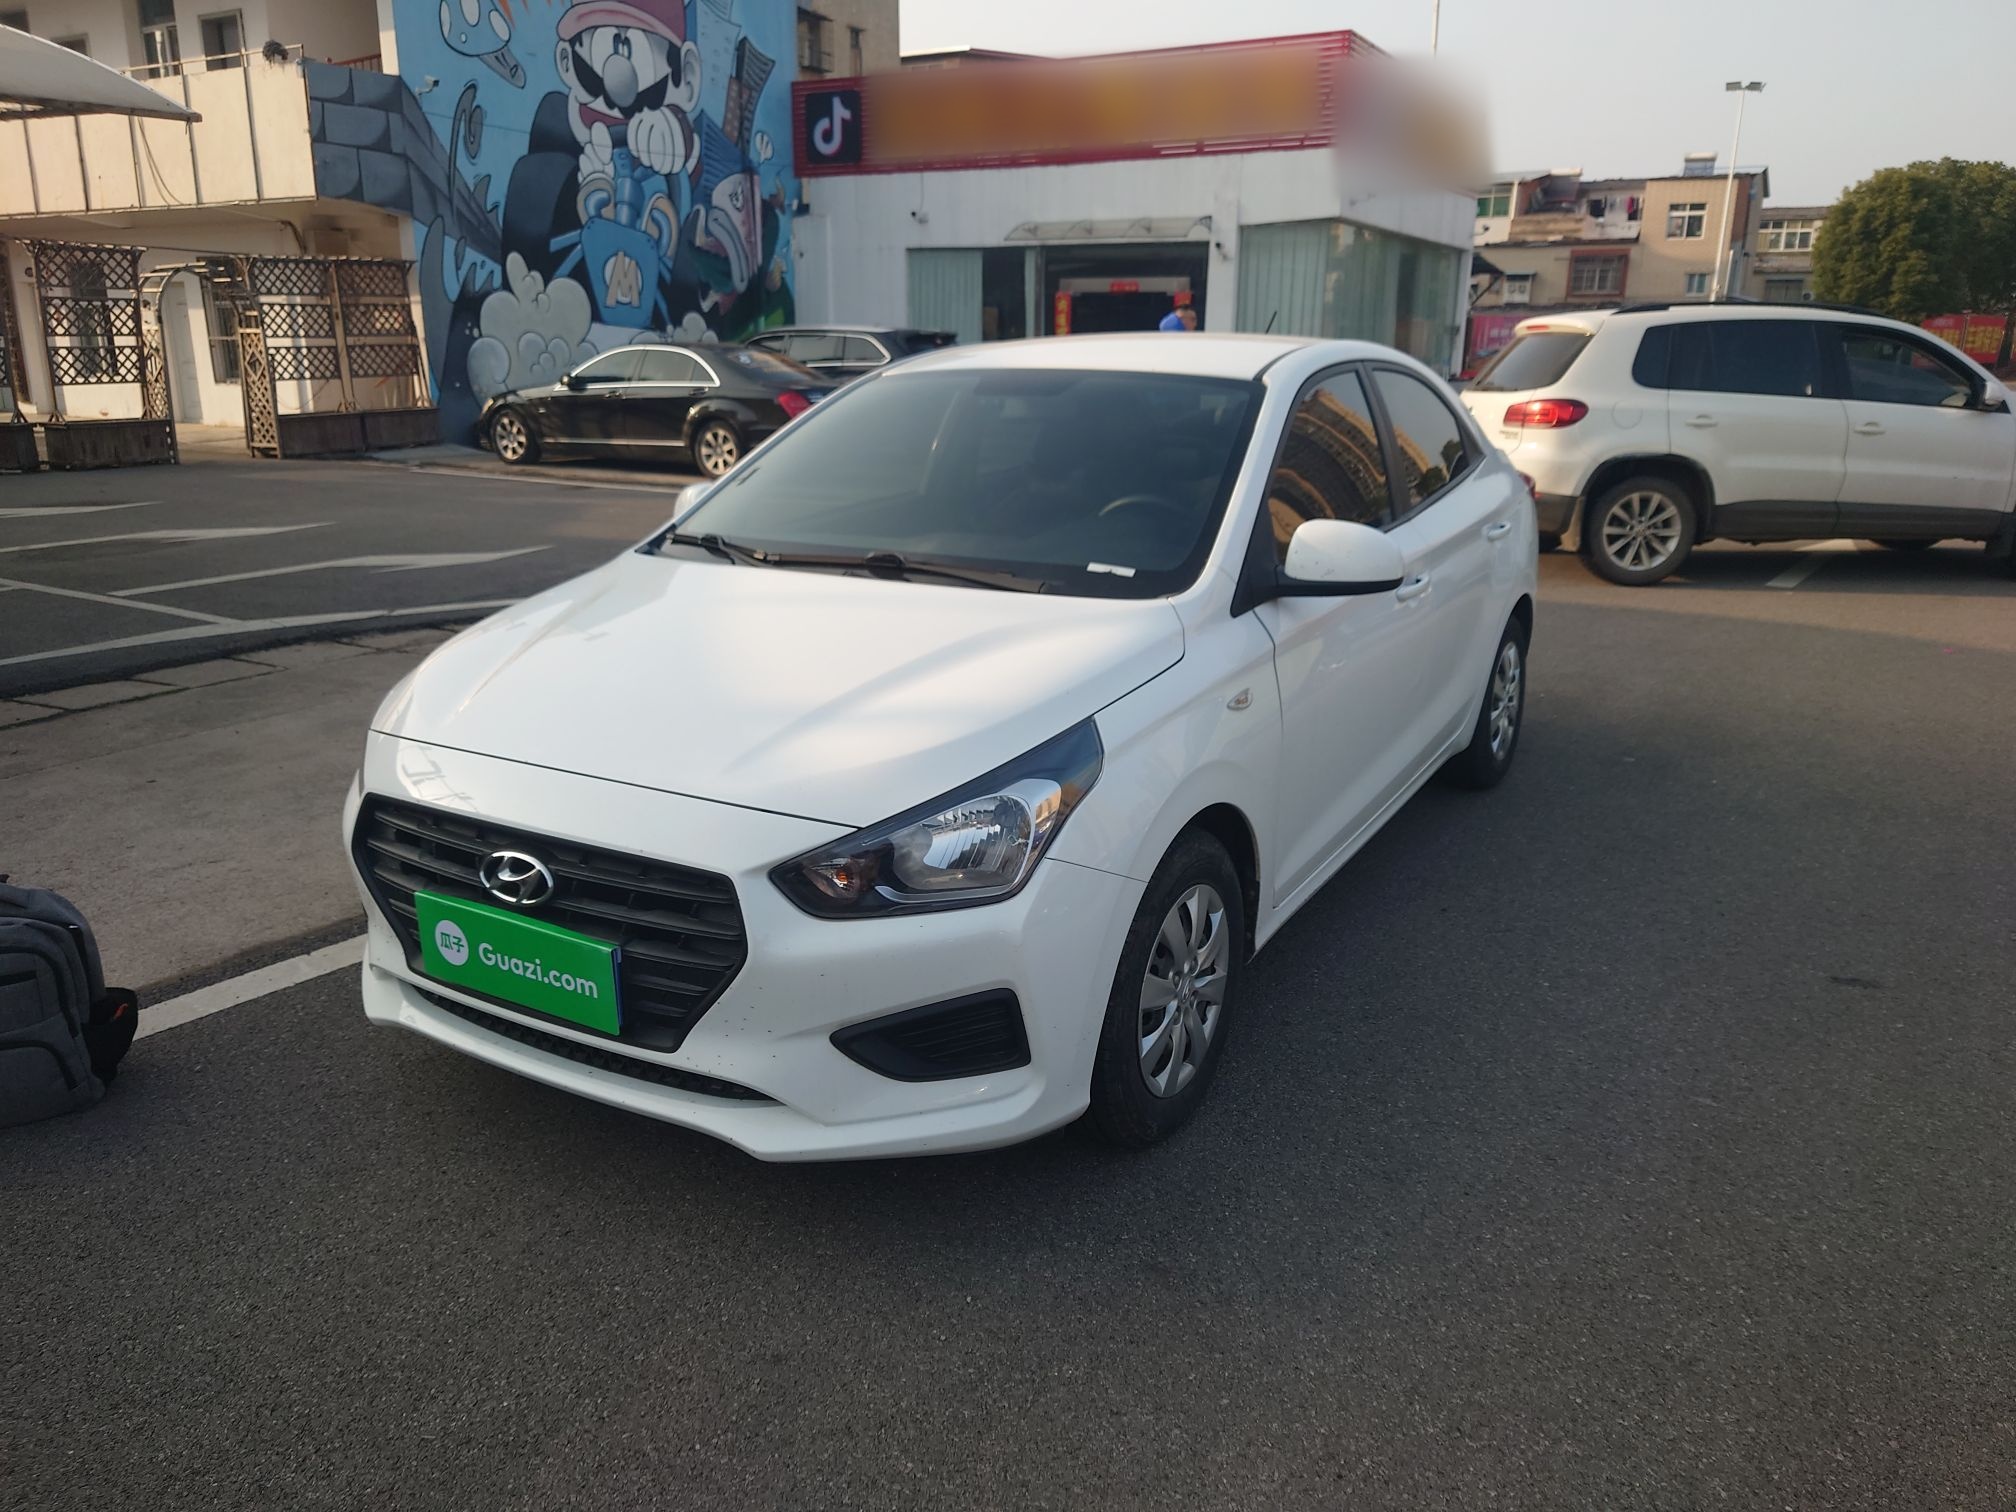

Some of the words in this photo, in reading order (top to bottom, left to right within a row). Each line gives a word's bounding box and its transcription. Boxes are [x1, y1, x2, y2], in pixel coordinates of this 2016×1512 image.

[604, 251, 640, 308] M
[440, 932, 465, 953] 瓜子
[478, 942, 598, 998] Guazi.com
